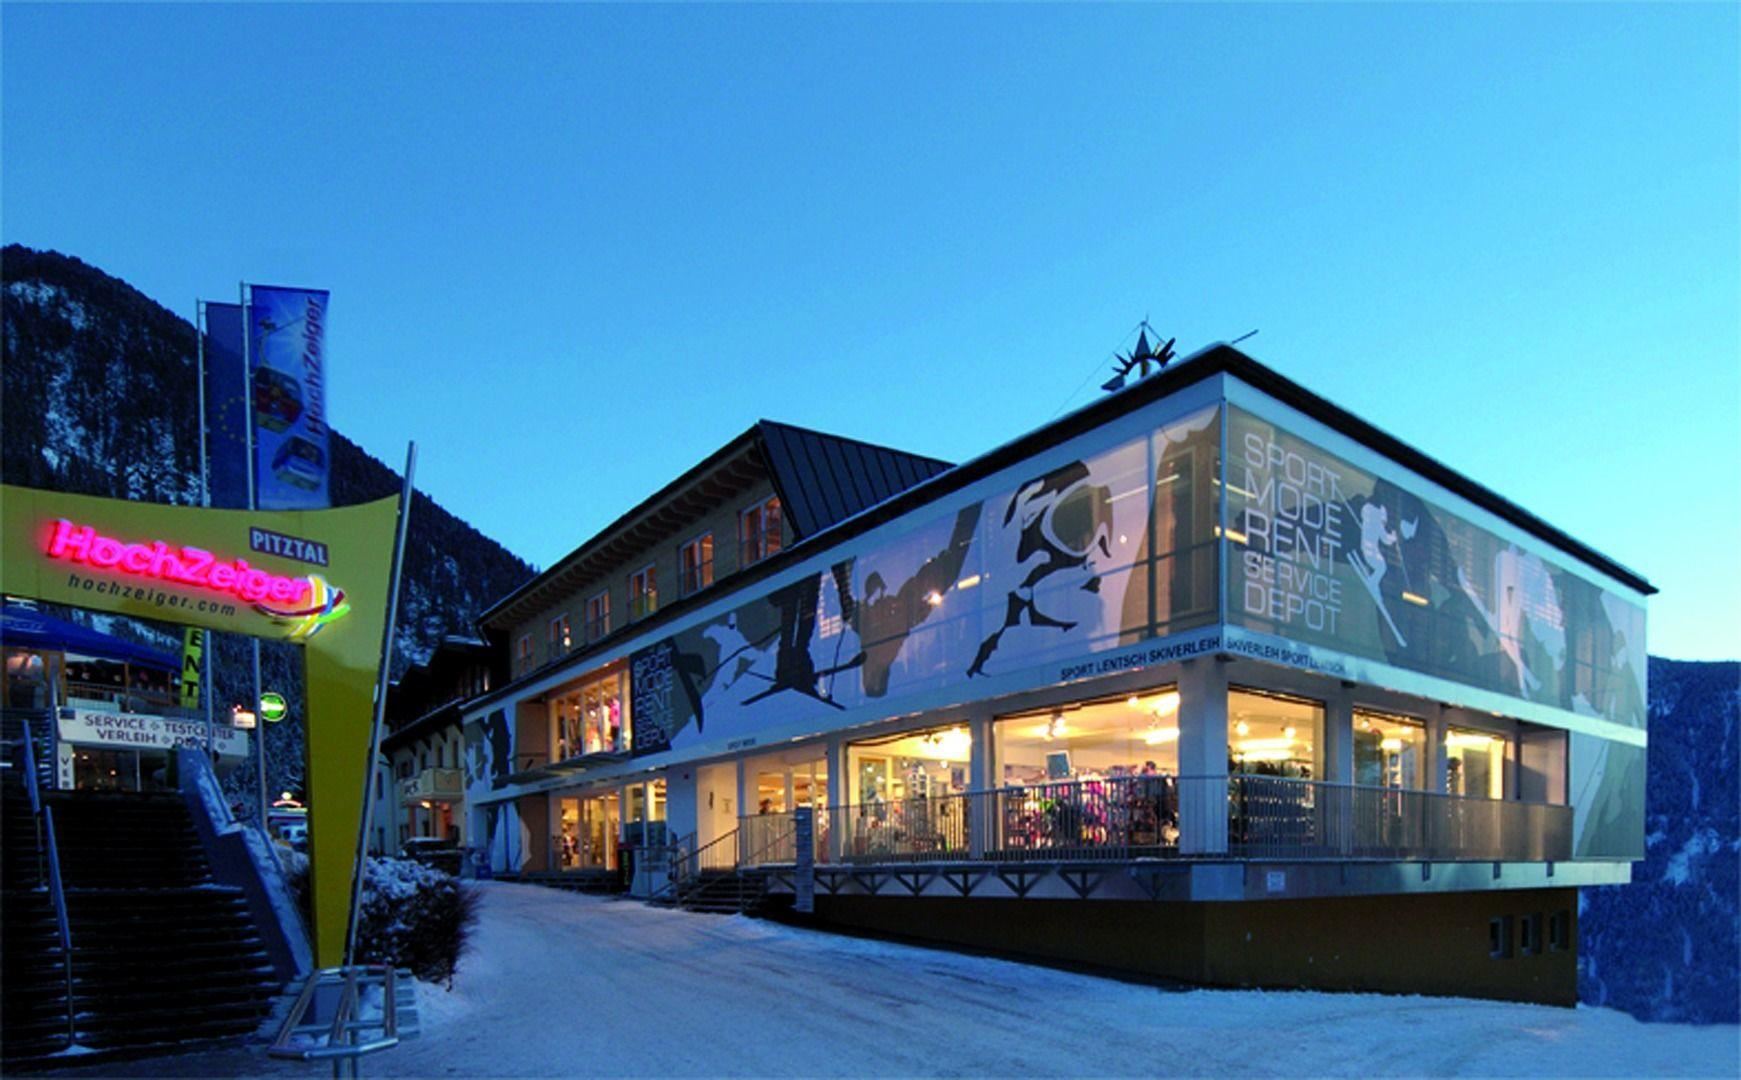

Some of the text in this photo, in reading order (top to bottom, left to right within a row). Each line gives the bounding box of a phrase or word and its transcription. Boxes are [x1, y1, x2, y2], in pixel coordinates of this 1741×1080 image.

[1244, 432, 1341, 501] SPORT
[1244, 466, 1342, 538] MODE
[48, 518, 310, 605] HochZeiger
[251, 530, 327, 565] PITZTAL
[1244, 506, 1342, 576] RENT
[68, 573, 236, 616] hochzeiger.com
[1243, 550, 1342, 606] SERVICE
[1244, 579, 1342, 635] DEPOT
[1061, 635, 1220, 681] SPORT LENTSCH SKIVERLEIH
[1226, 636, 1280, 659] SKIVERLEIH
[84, 714, 146, 731] SERVICE
[96, 729, 157, 745] VERLEIH
